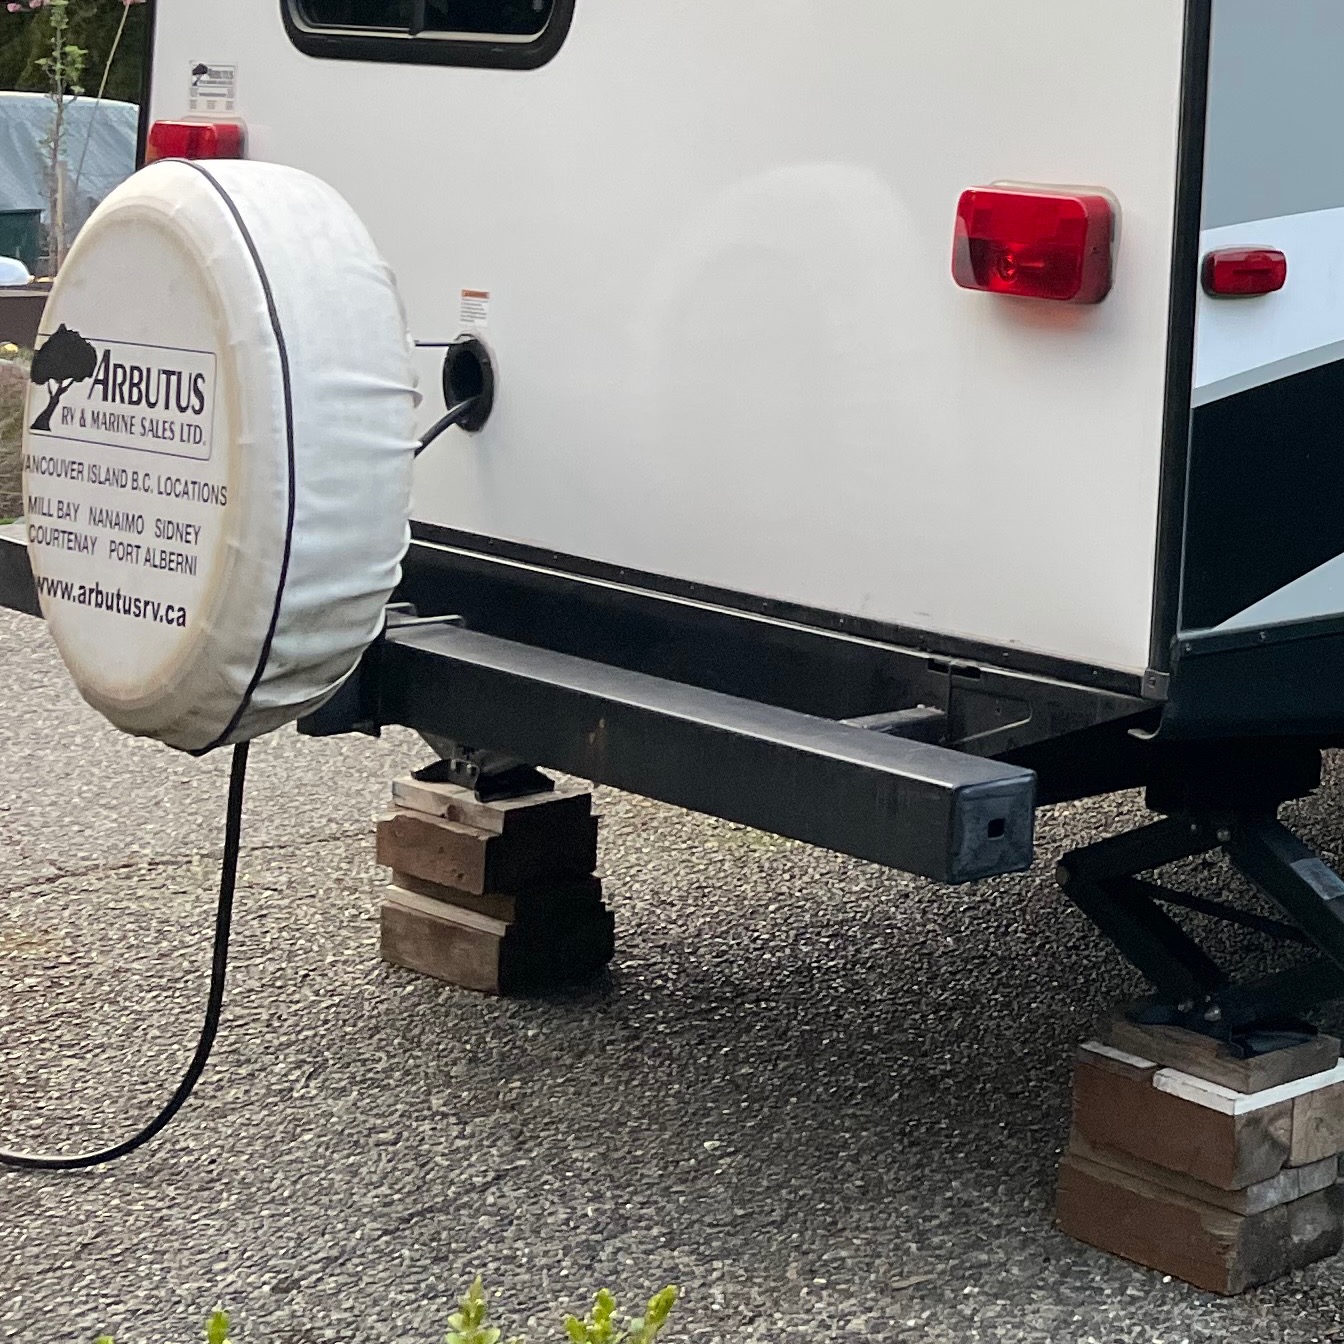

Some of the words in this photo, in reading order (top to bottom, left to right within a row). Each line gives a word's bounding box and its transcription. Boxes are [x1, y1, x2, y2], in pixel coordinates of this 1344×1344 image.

[86, 348, 206, 416] ARBUTUS
[61, 406, 76, 426] RV
[79, 409, 87, 428] &
[90, 410, 135, 435] MARINE
[139, 416, 175, 441] SALES
[179, 422, 207, 446] LTD.
[23, 454, 84, 481] ANCOUVER
[87, 463, 128, 489] ISLAND
[131, 470, 154, 493] B.C.
[157, 475, 228, 506] LOCATIONS
[28, 495, 53, 518] MILL
[56, 500, 80, 522] BAY
[88, 506, 144, 535] NANAIMO
[154, 518, 202, 546] SIDNEY
[28, 524, 97, 556] COURTENAY
[108, 540, 141, 565] PORT
[143, 547, 198, 576] ALBERNI
